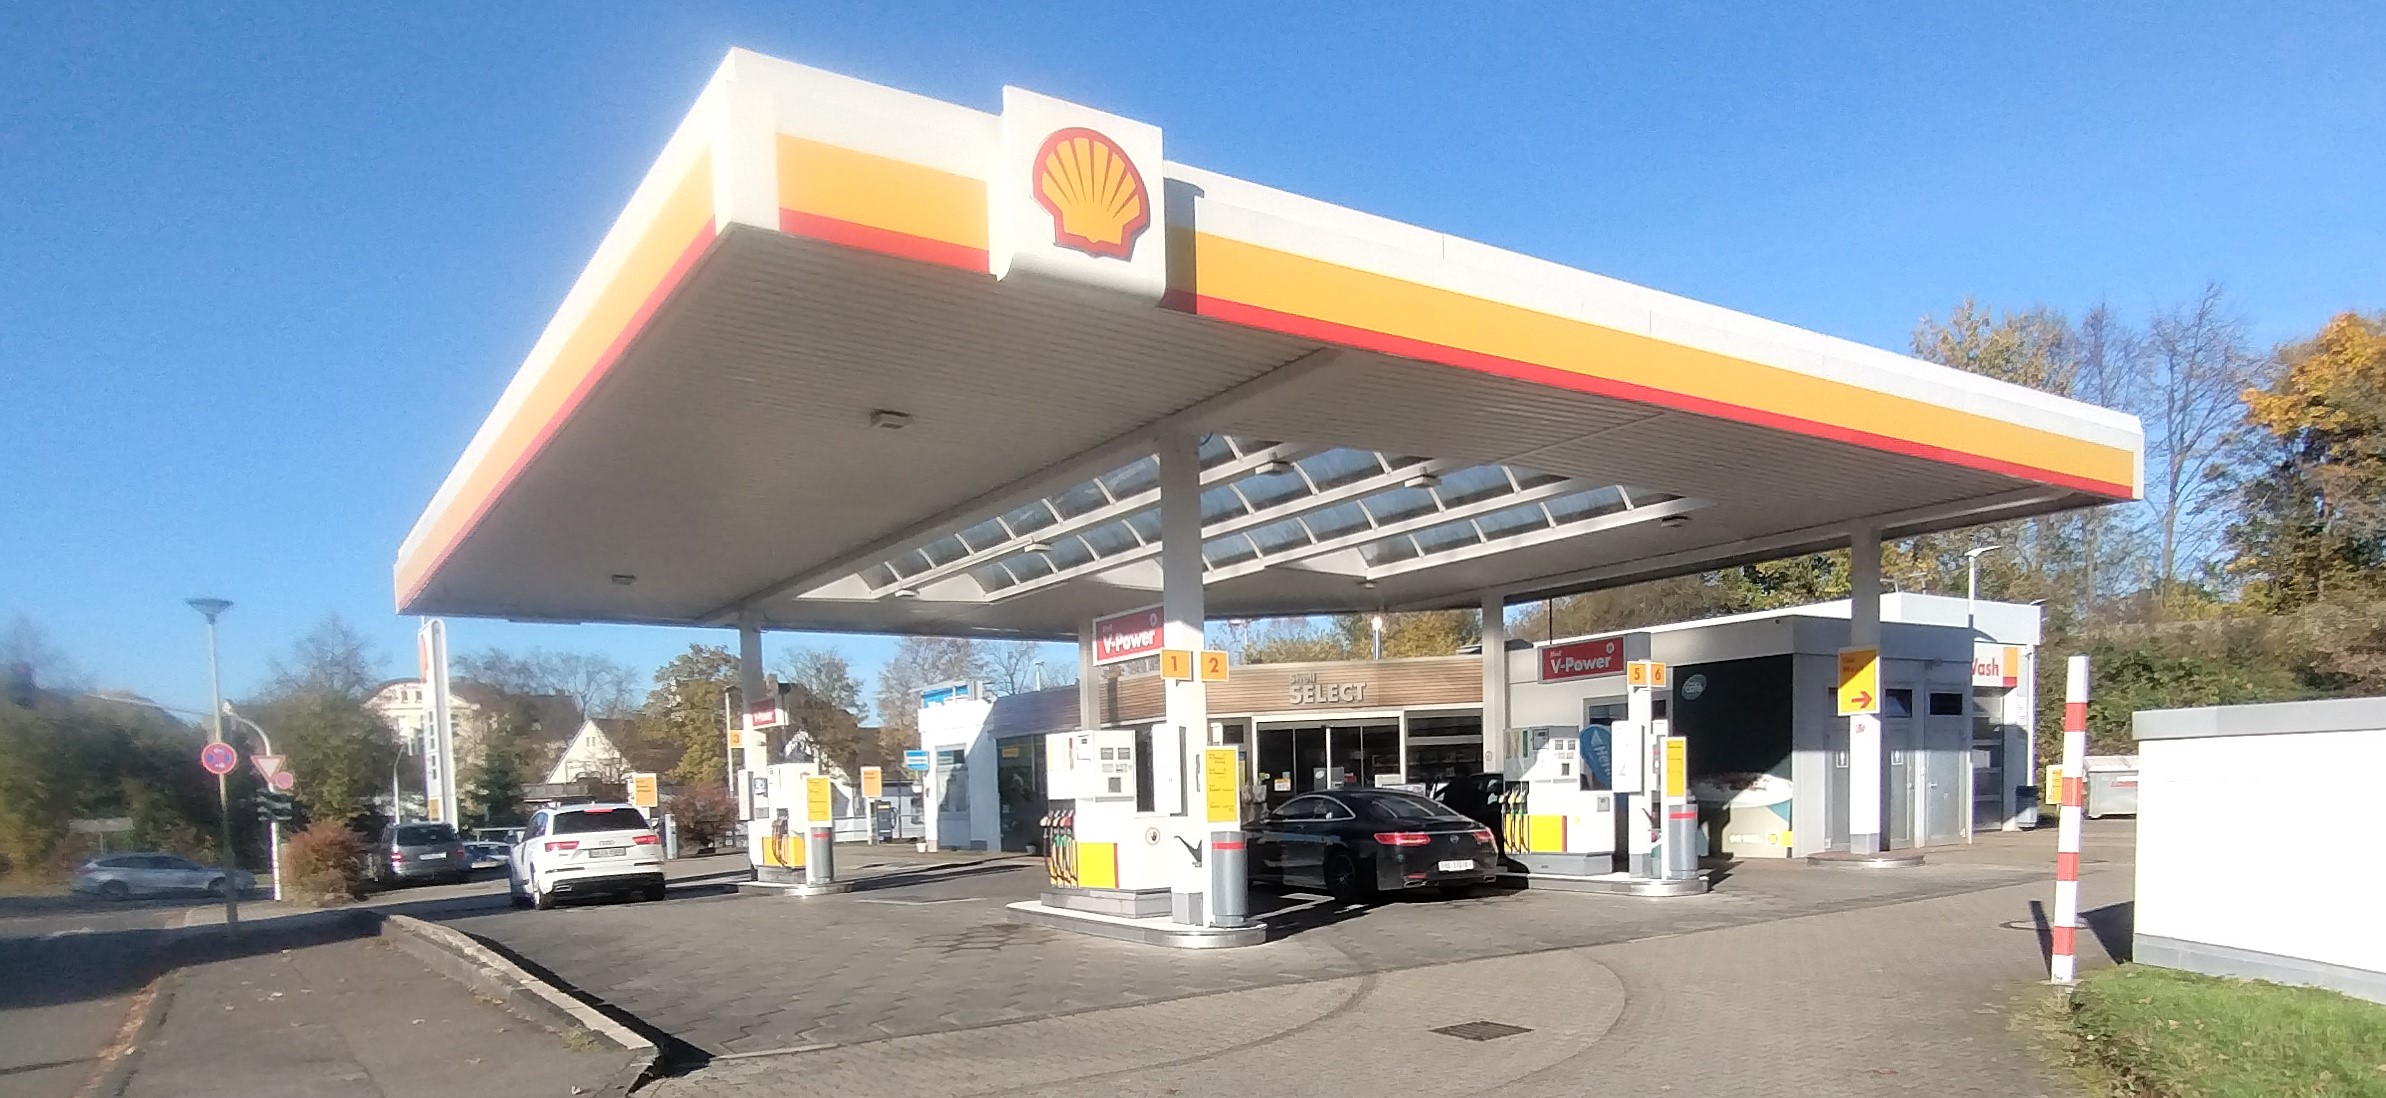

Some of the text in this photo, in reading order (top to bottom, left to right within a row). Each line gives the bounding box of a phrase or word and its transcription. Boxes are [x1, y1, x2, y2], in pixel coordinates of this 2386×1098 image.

[1103, 630, 1155, 653] V-Power
[1171, 656, 1177, 671] 1
[1209, 657, 1219, 672] 2
[1550, 655, 1612, 674] V-Power
[1634, 668, 1640, 680] 5
[1655, 669, 1661, 680] 6
[1290, 682, 1366, 704] SELECT
[733, 734, 739, 743] 3
